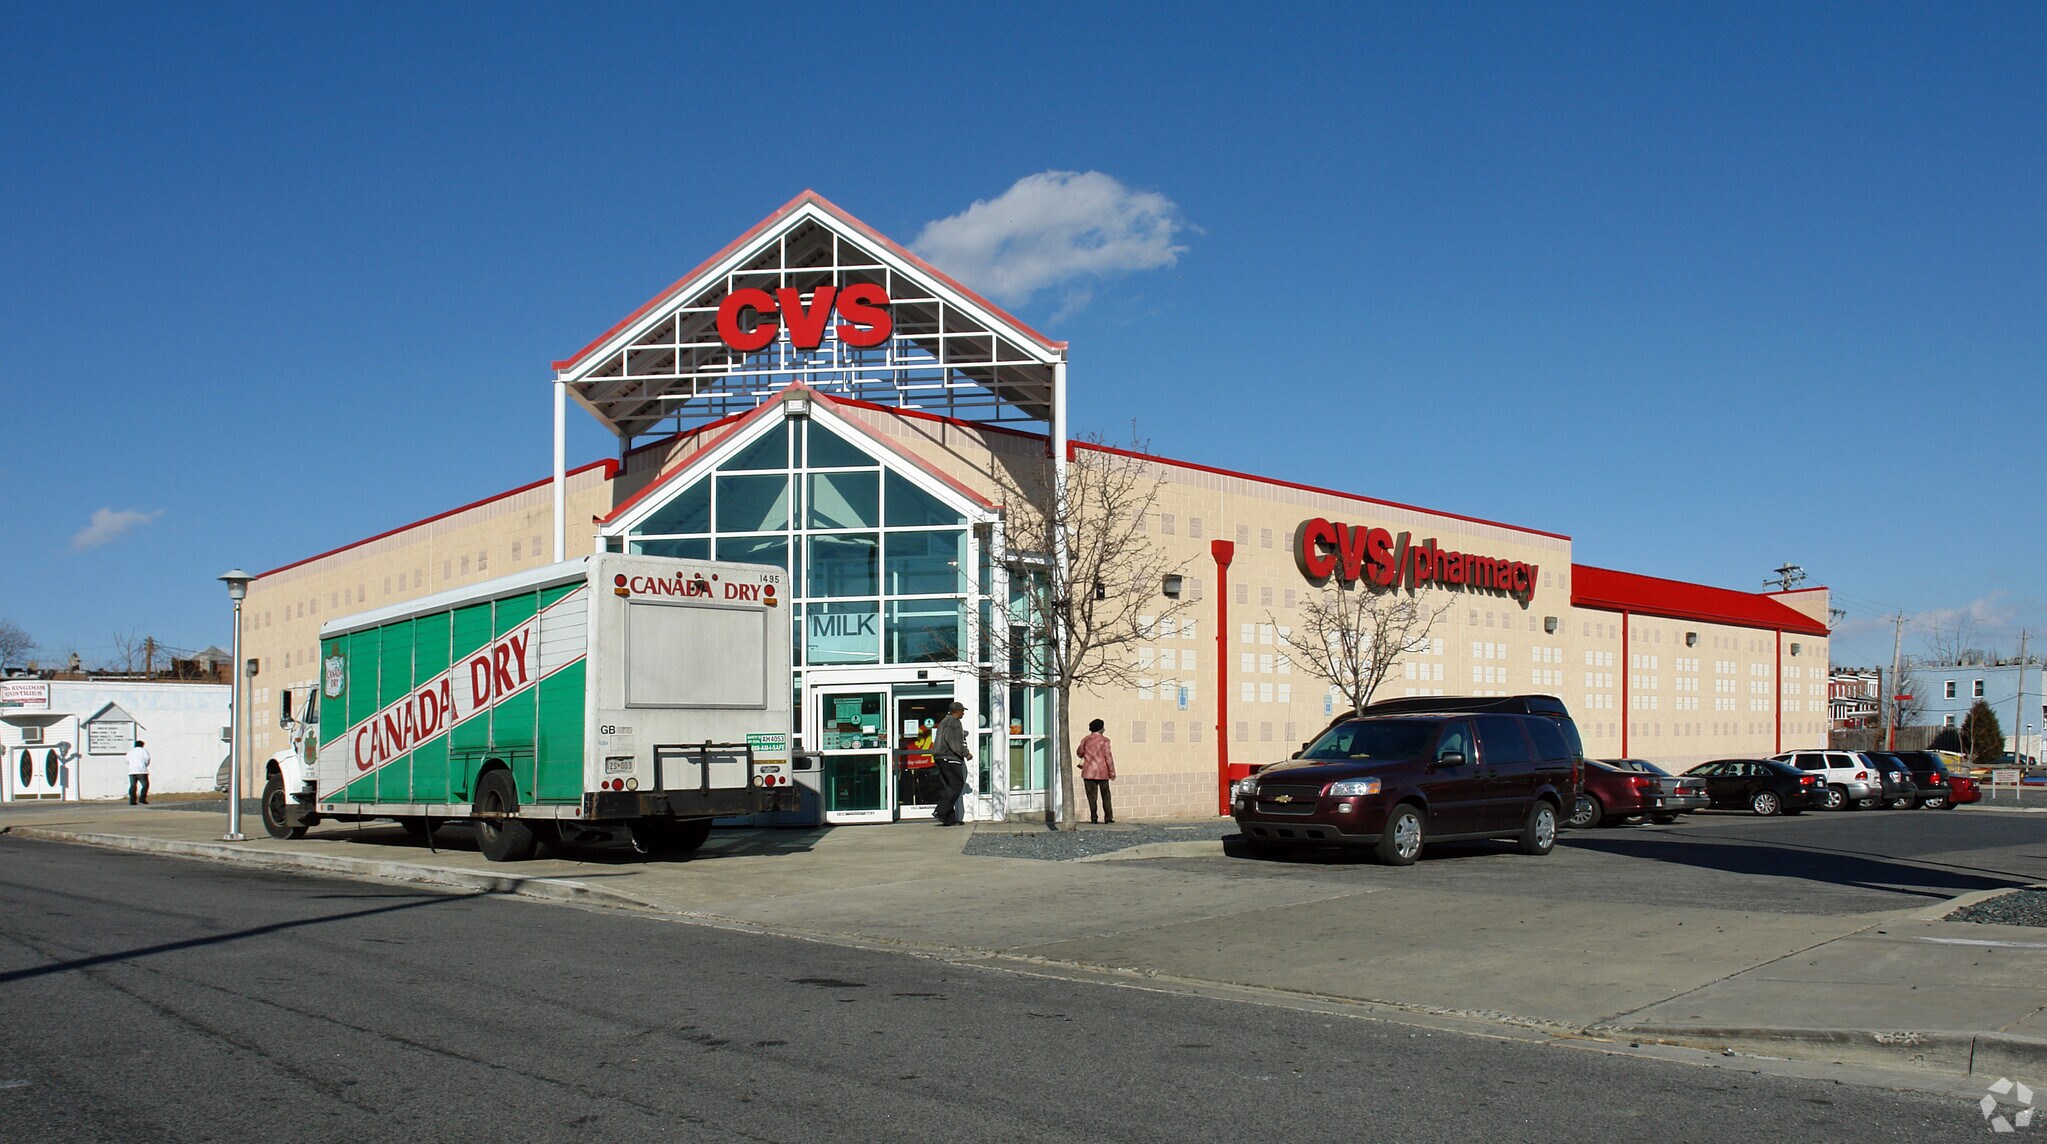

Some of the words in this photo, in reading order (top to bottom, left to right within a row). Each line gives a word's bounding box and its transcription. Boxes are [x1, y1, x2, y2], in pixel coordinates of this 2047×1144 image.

[716, 283, 893, 351] CVS
[1298, 517, 1540, 601] CVS/pharmacy
[629, 576, 714, 599] CANADA
[724, 582, 762, 601] DRY
[759, 574, 780, 584] 1495
[813, 613, 876, 637] MILK
[354, 676, 460, 772] CANADA
[469, 626, 530, 711] DRY
[600, 725, 616, 735] GB
